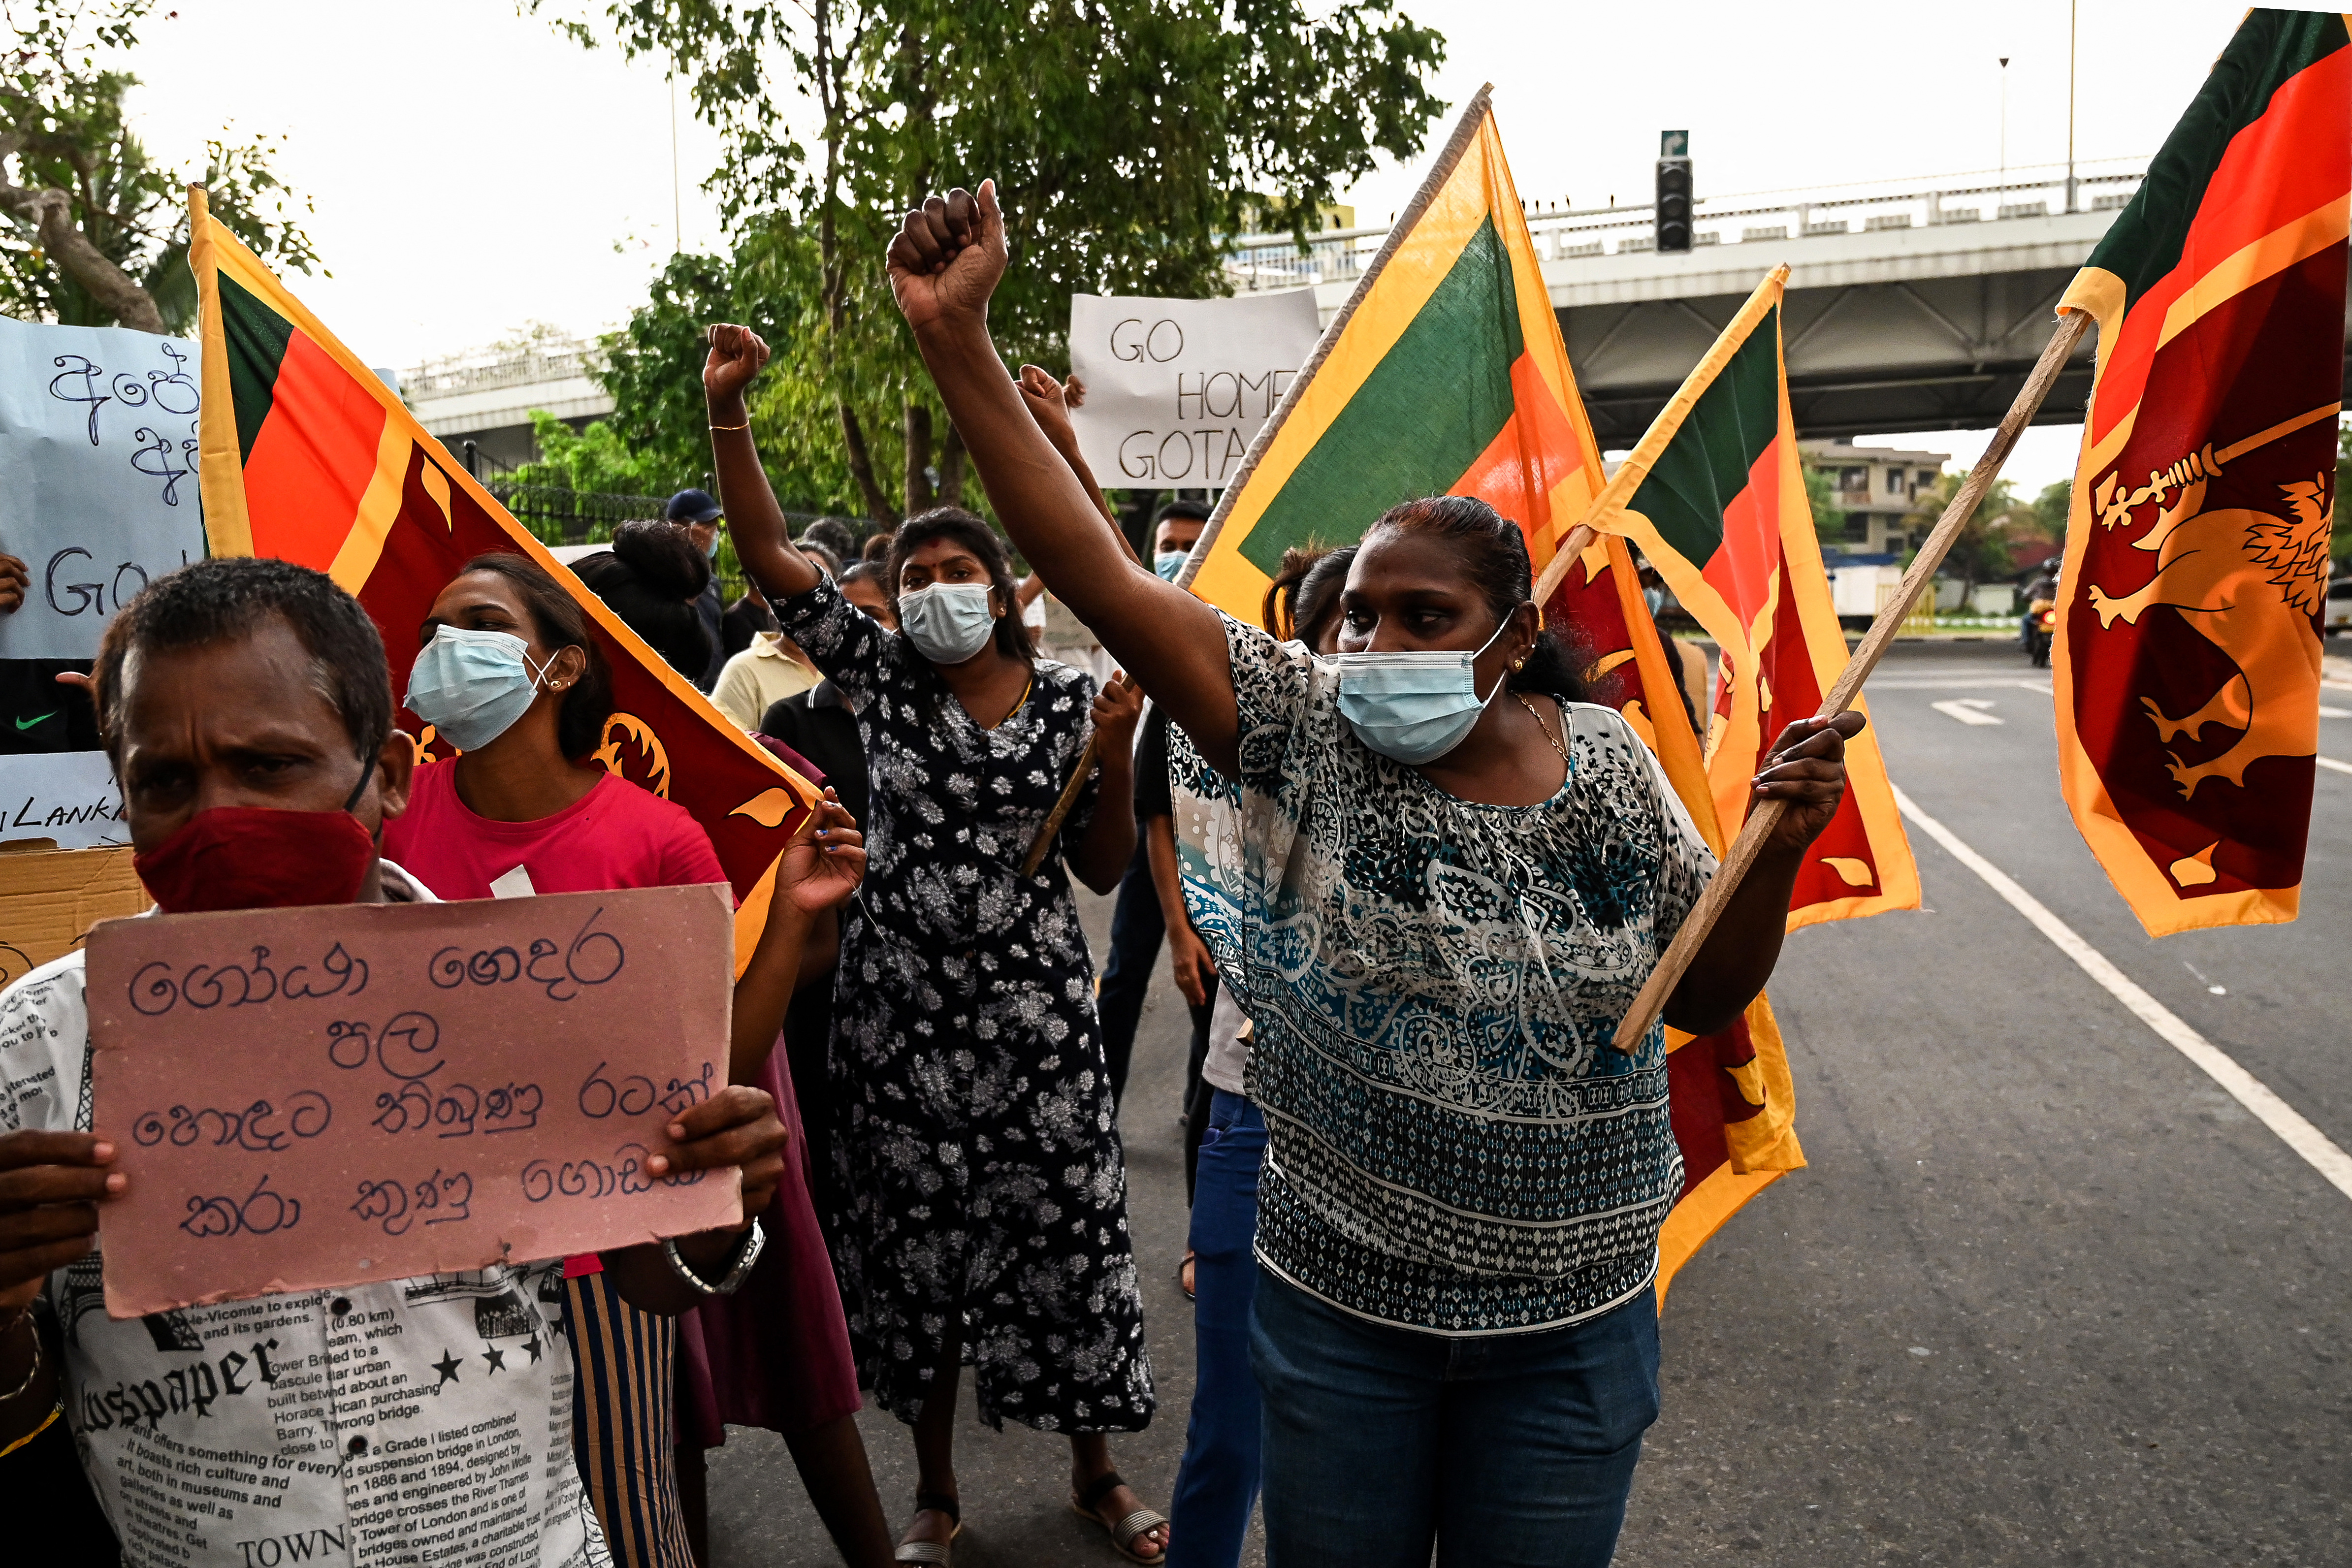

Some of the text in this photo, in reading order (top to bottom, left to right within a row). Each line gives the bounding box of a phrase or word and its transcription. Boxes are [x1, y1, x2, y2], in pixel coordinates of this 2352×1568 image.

[1111, 319, 1184, 363] GO
[1119, 427, 1246, 480] GOTA
[45, 546, 149, 616] GO
[327, 1010, 445, 1080] පල
[234, 1319, 250, 1334] its
[254, 1313, 314, 1332] gardens.
[268, 1302, 281, 1312] to
[369, 1308, 395, 1322] km)
[365, 1323, 403, 1340] which
[354, 1348, 366, 1359] to
[370, 1346, 379, 1355] a
[354, 1360, 390, 1376] urban
[267, 1393, 297, 1408] built
[350, 1377, 388, 1394] about
[391, 1374, 407, 1384] an
[371, 1383, 442, 1408] purchasing
[274, 1407, 324, 1424] Horace
[379, 1404, 424, 1421] bridge.
[281, 1439, 334, 1456] close to
[386, 1436, 428, 1454] Grade
[438, 1426, 469, 1442] listed
[472, 1410, 517, 1435] combined
[136, 1444, 173, 1469] boasts
[176, 1459, 202, 1477] rich
[205, 1467, 258, 1485] culture
[261, 1476, 291, 1490] and
[154, 1433, 185, 1454] offers
[188, 1445, 268, 1470] something
[272, 1454, 295, 1471] for
[357, 1452, 434, 1476] suspension
[437, 1441, 474, 1461] bridge
[476, 1437, 485, 1450] in
[487, 1428, 522, 1448] London,
[364, 1473, 397, 1490] 1886
[401, 1468, 427, 1484] and
[431, 1460, 464, 1478] 1894,
[466, 1446, 510, 1470] designed
[511, 1443, 521, 1457] by
[138, 1462, 164, 1483] both
[166, 1474, 179, 1489] in
[181, 1480, 249, 1504] museums
[252, 1494, 283, 1509] and
[351, 1509, 394, 1527] bridge
[397, 1498, 449, 1517] crosses
[451, 1493, 470, 1507] the
[472, 1483, 497, 1501] River
[499, 1471, 530, 1491] Thames
[374, 1490, 399, 1506] and
[402, 1475, 473, 1502] engineered
[475, 1471, 487, 1486] by
[489, 1464, 510, 1478] John
[175, 1515, 198, 1530] and
[187, 1501, 216, 1515] well
[218, 1506, 234, 1520] as
[360, 1524, 401, 1541] Tower
[405, 1518, 418, 1532] of
[421, 1510, 468, 1531] London
[470, 1501, 489, 1517] and
[491, 1500, 499, 1510] is
[501, 1493, 517, 1506] one
[518, 1487, 526, 1499] of
[185, 1533, 208, 1550] Get
[236, 1524, 346, 1568] TOWN
[359, 1539, 408, 1559] bridges
[412, 1529, 455, 1548] owned
[458, 1520, 478, 1537] and
[480, 1503, 528, 1530] maintained
[375, 1554, 419, 1568] House
[422, 1544, 469, 1563] Estates,
[471, 1538, 479, 1548] a
[482, 1520, 525, 1545] charitable
[465, 1551, 487, 1565] was
[489, 1529, 539, 1558] constructed
[508, 1553, 518, 1567] of
